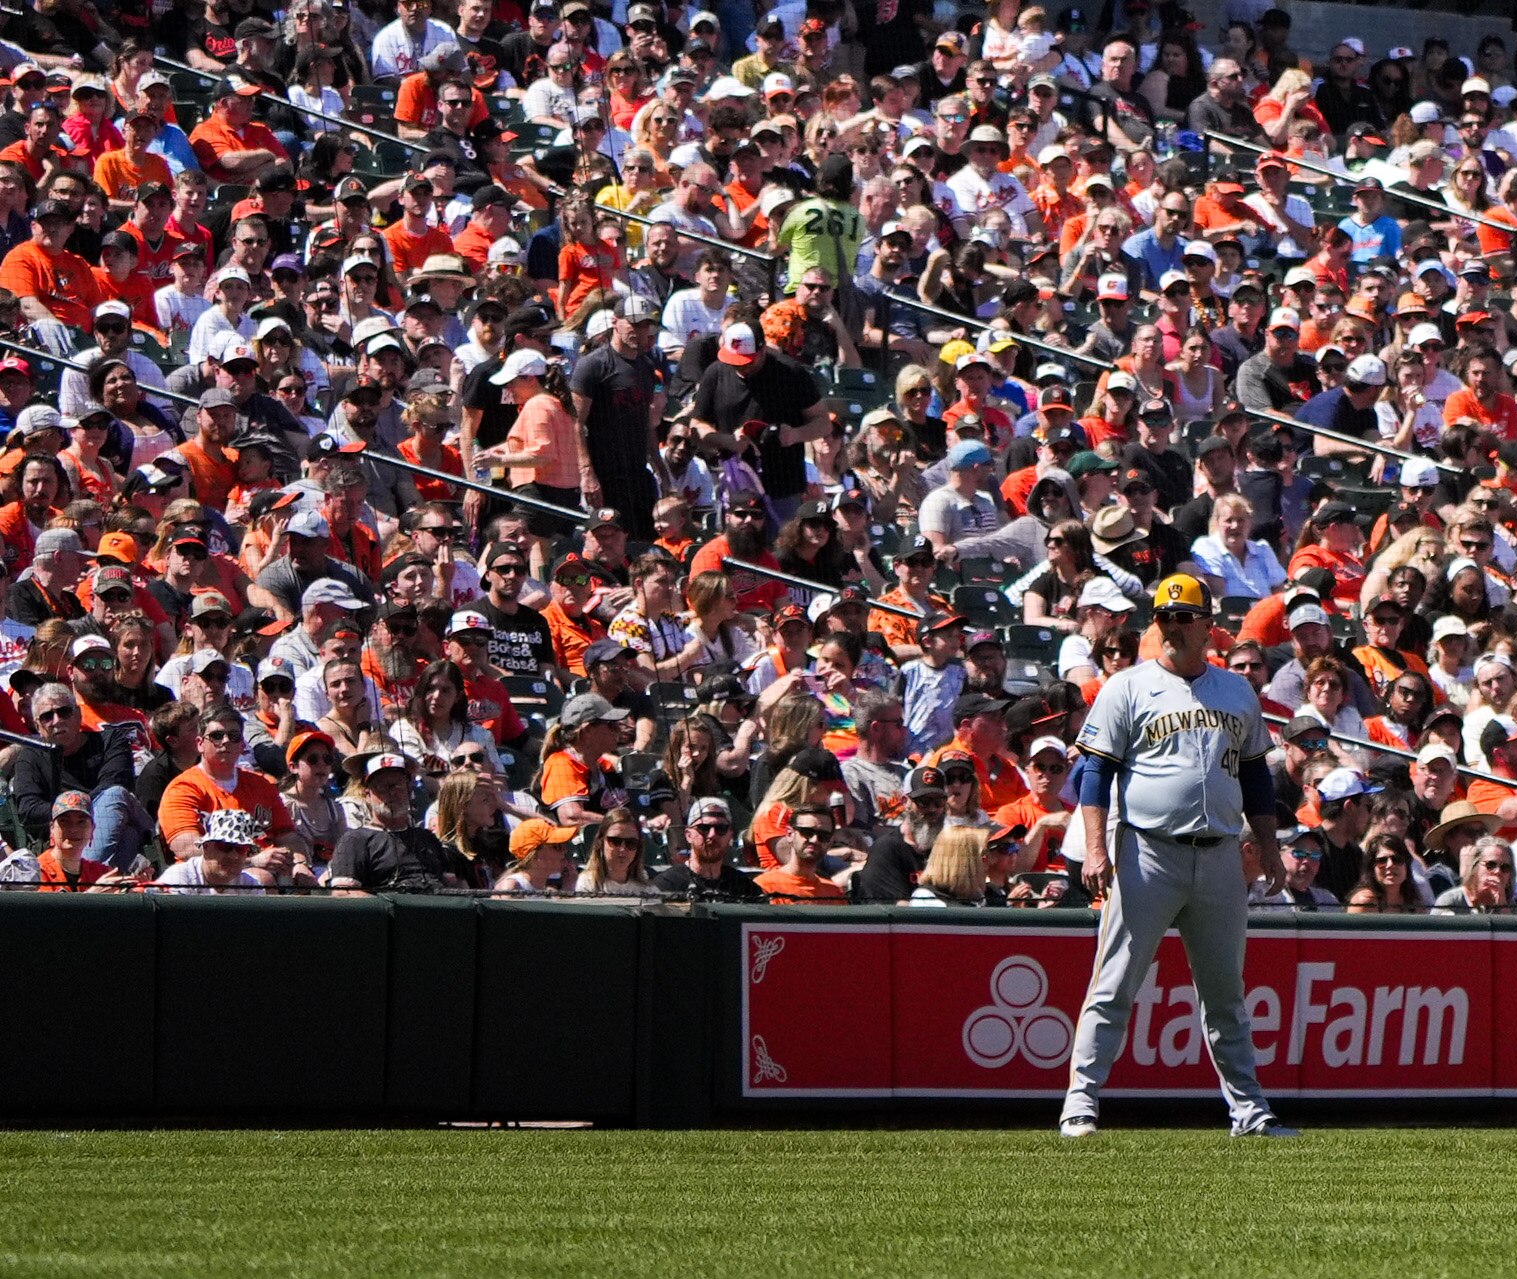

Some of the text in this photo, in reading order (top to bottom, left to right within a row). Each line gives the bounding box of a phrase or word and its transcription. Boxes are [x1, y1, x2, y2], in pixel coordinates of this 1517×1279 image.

[805, 208, 859, 242] 261
[1112, 962, 1469, 1068] tae Farm
